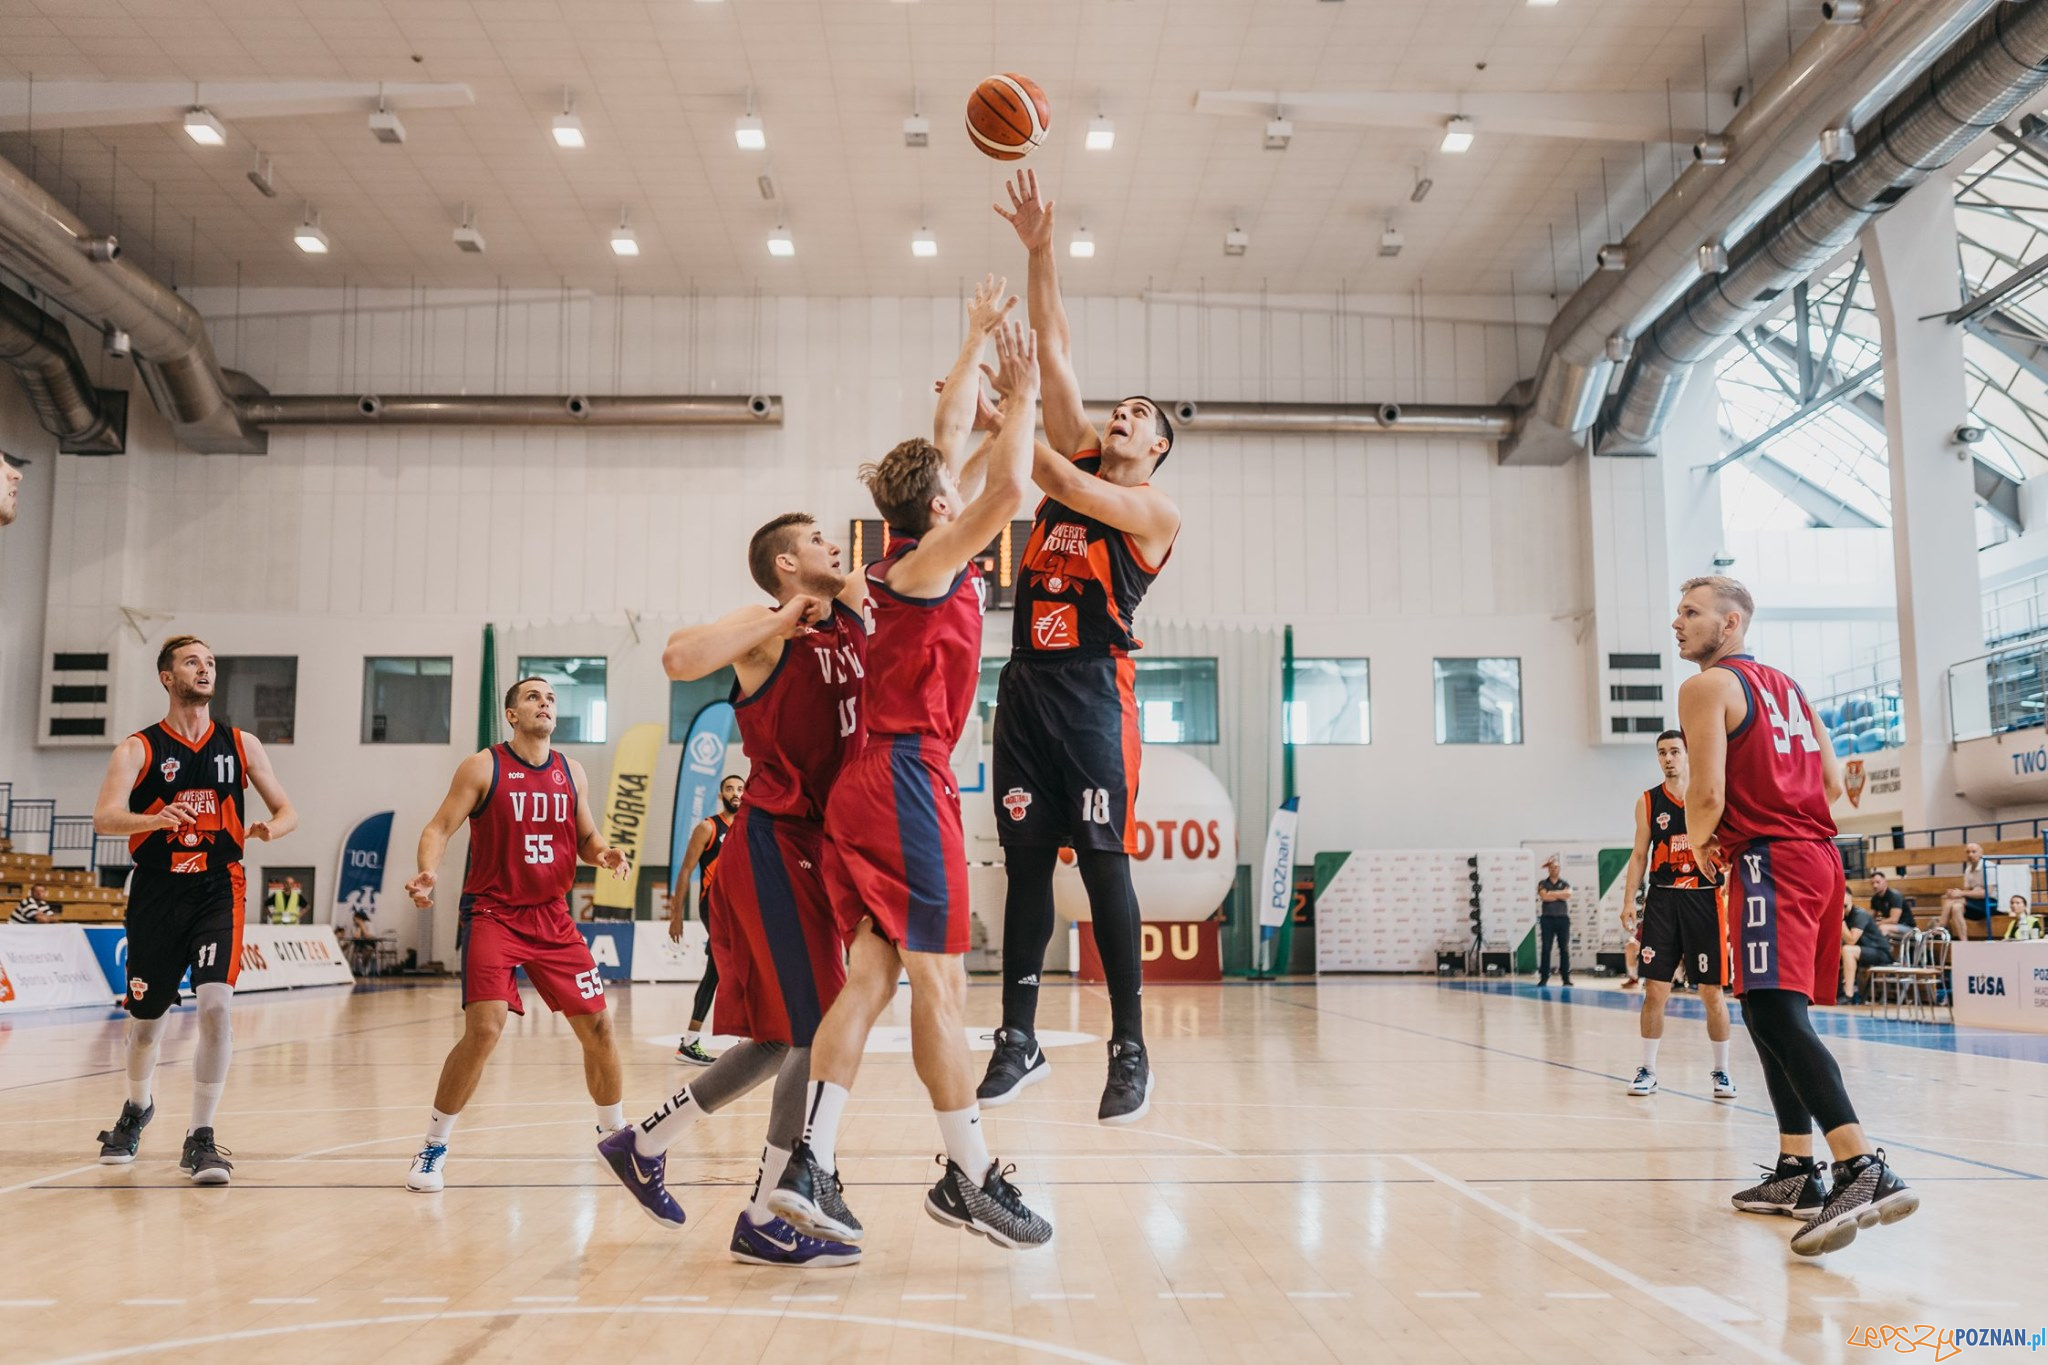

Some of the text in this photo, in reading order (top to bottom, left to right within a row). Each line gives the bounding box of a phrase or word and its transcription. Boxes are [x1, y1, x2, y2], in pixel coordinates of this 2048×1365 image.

[1760, 688, 1820, 754] 34
[214, 754, 235, 783] 11
[509, 791, 568, 822] VDU
[1082, 788, 1110, 824] 18
[524, 834, 554, 864] 55
[1131, 819, 1221, 861] OTOS
[1743, 854, 1769, 974] VDU
[273, 941, 330, 961] CITYZEN
[1141, 923, 1199, 961] DU
[1698, 953, 1708, 973] 8
[575, 967, 604, 1000] 55
[1968, 975, 2006, 996] EUSA
